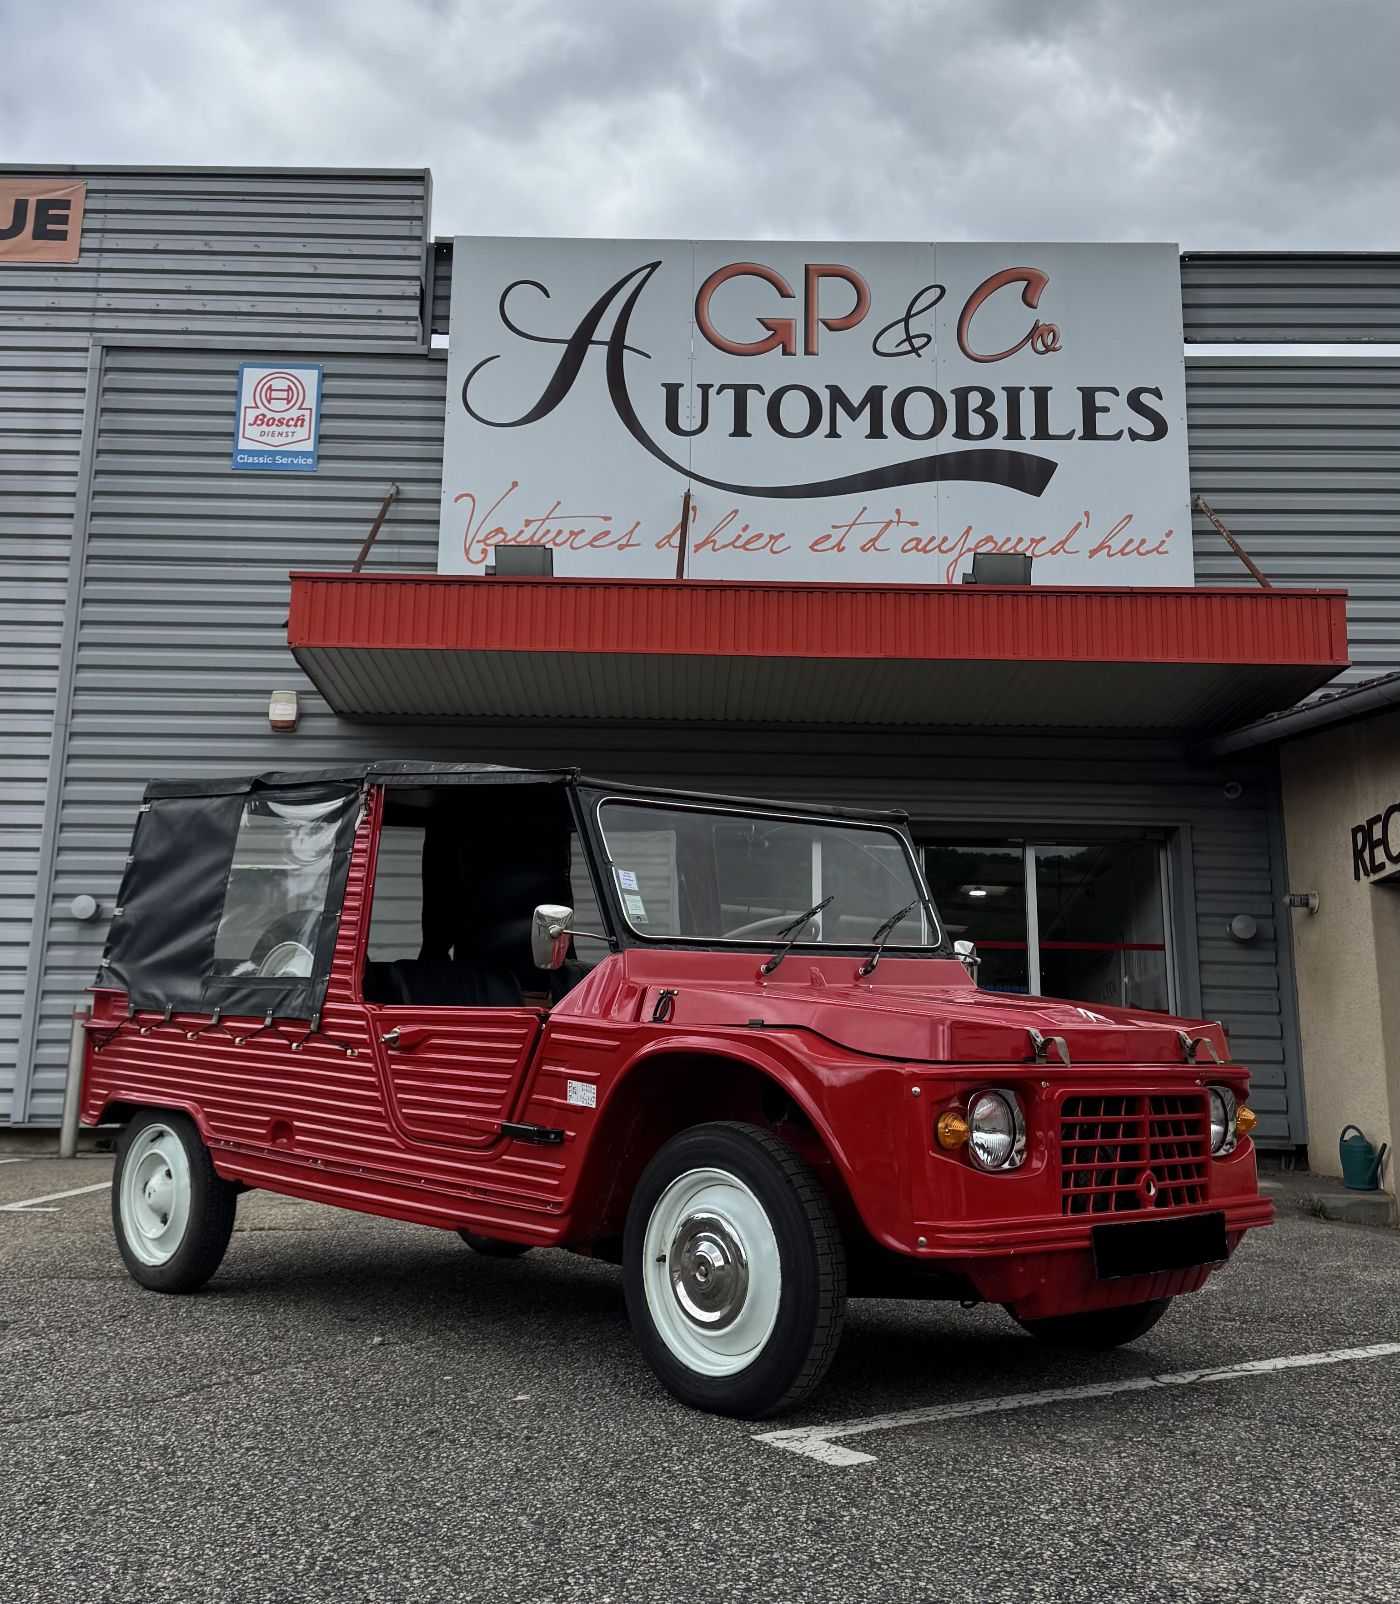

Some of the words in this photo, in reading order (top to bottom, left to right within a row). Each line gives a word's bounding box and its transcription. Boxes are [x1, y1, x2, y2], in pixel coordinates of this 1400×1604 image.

[694, 262, 871, 357] GP
[872, 283, 946, 358] &
[956, 266, 1063, 364] Co
[462, 260, 1169, 499] AUTOMOBILES
[248, 413, 306, 428] Bosch
[259, 430, 296, 438] DIENST
[237, 454, 273, 464] Classic
[275, 455, 313, 465] Service
[454, 480, 640, 564] Voitures
[655, 504, 791, 554] d'hier
[808, 506, 866, 554] et
